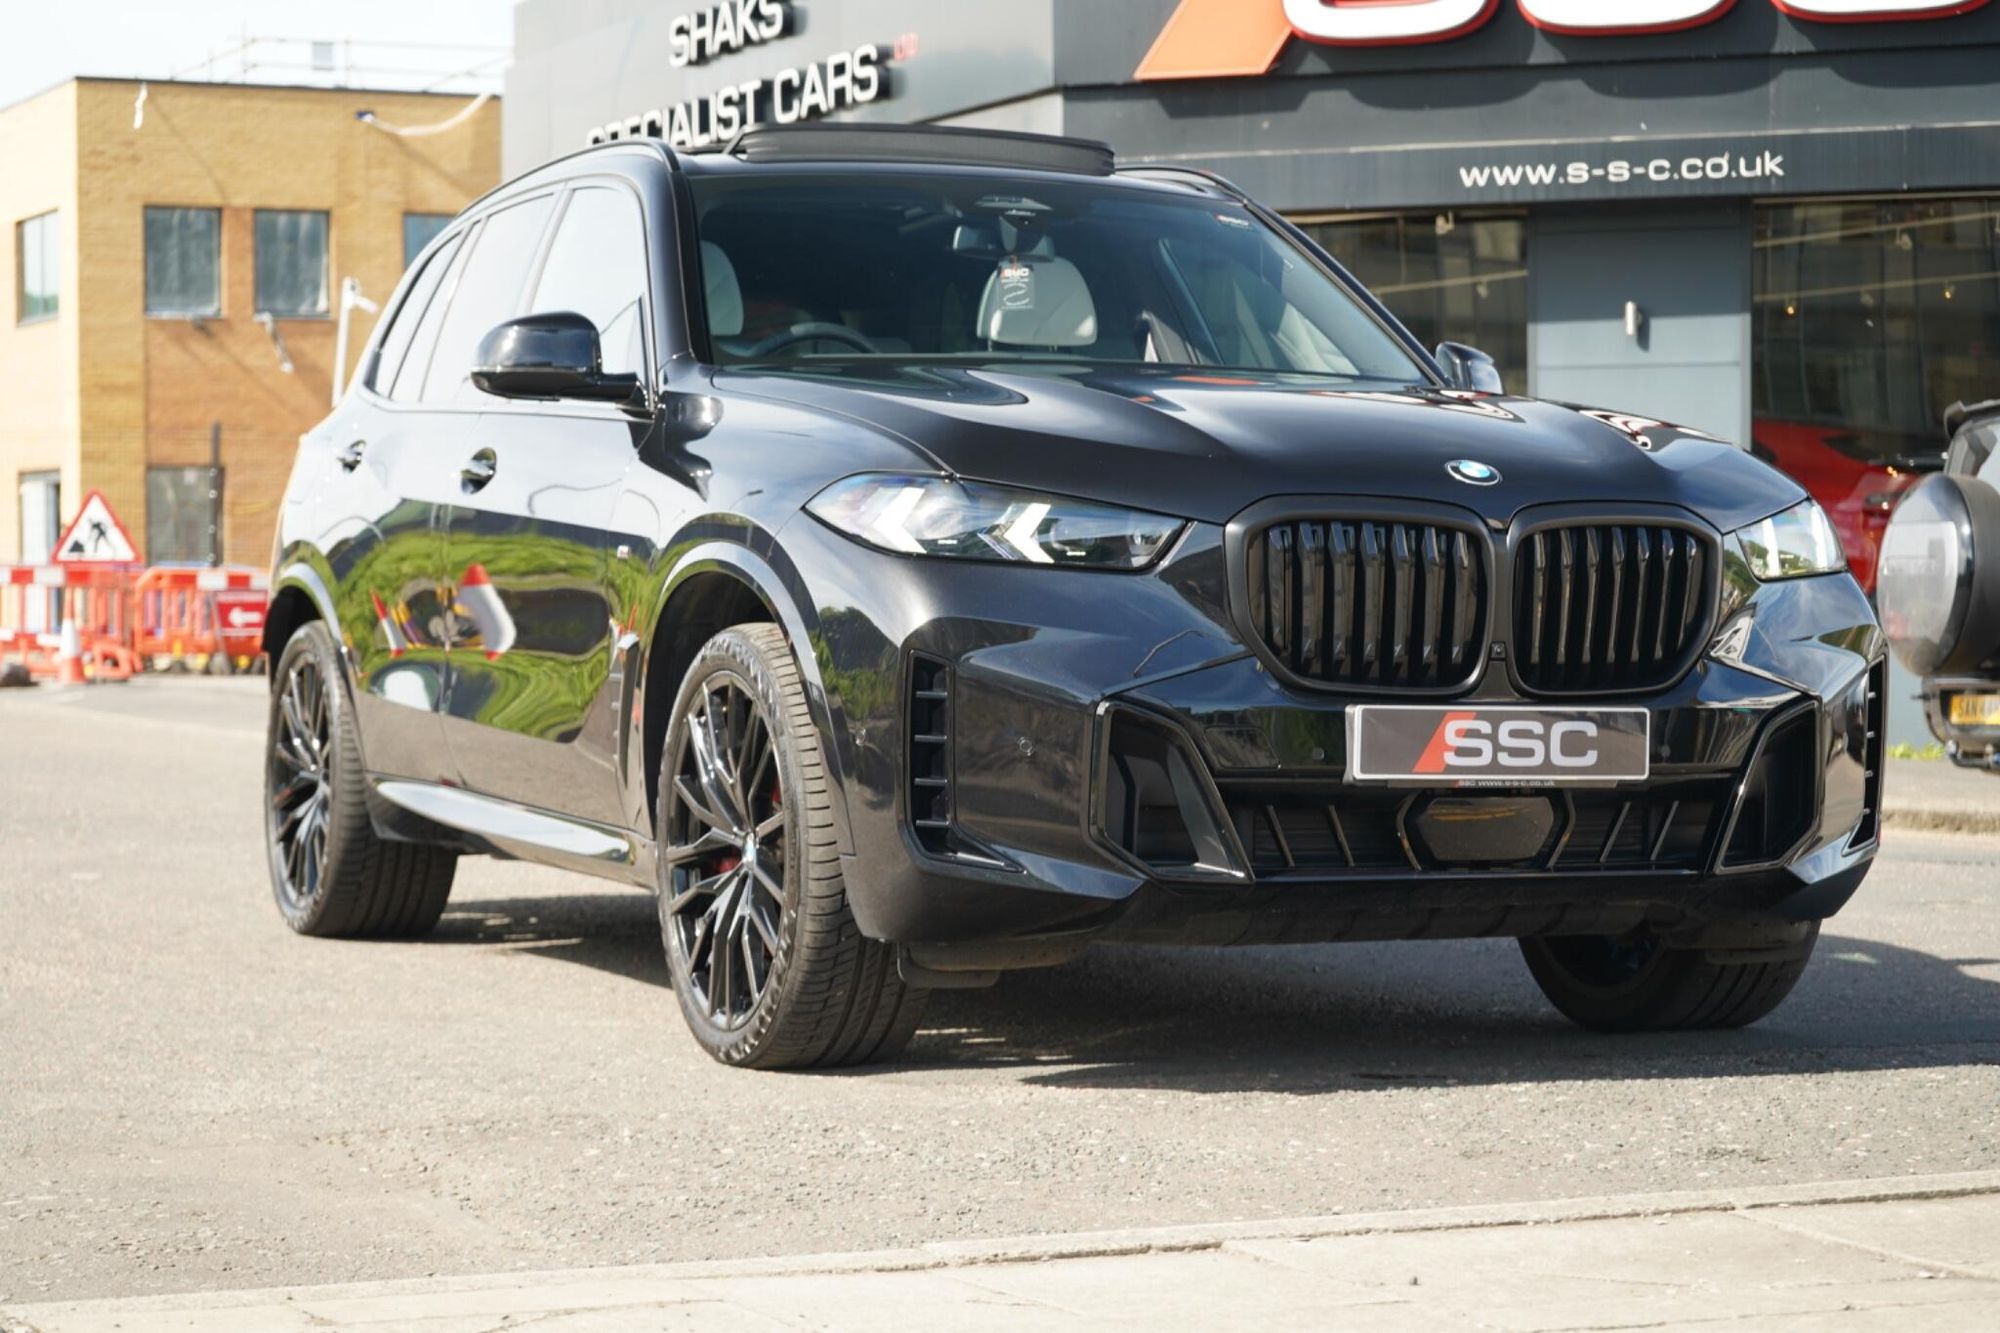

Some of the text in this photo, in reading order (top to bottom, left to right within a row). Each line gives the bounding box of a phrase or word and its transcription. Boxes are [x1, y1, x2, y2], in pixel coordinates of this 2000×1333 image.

[668, 0, 784, 67] SHAKS
[773, 43, 879, 124] CARS
[1459, 150, 1785, 188] www.s-s-c.co.uk
[1443, 719, 1598, 767] SSC
